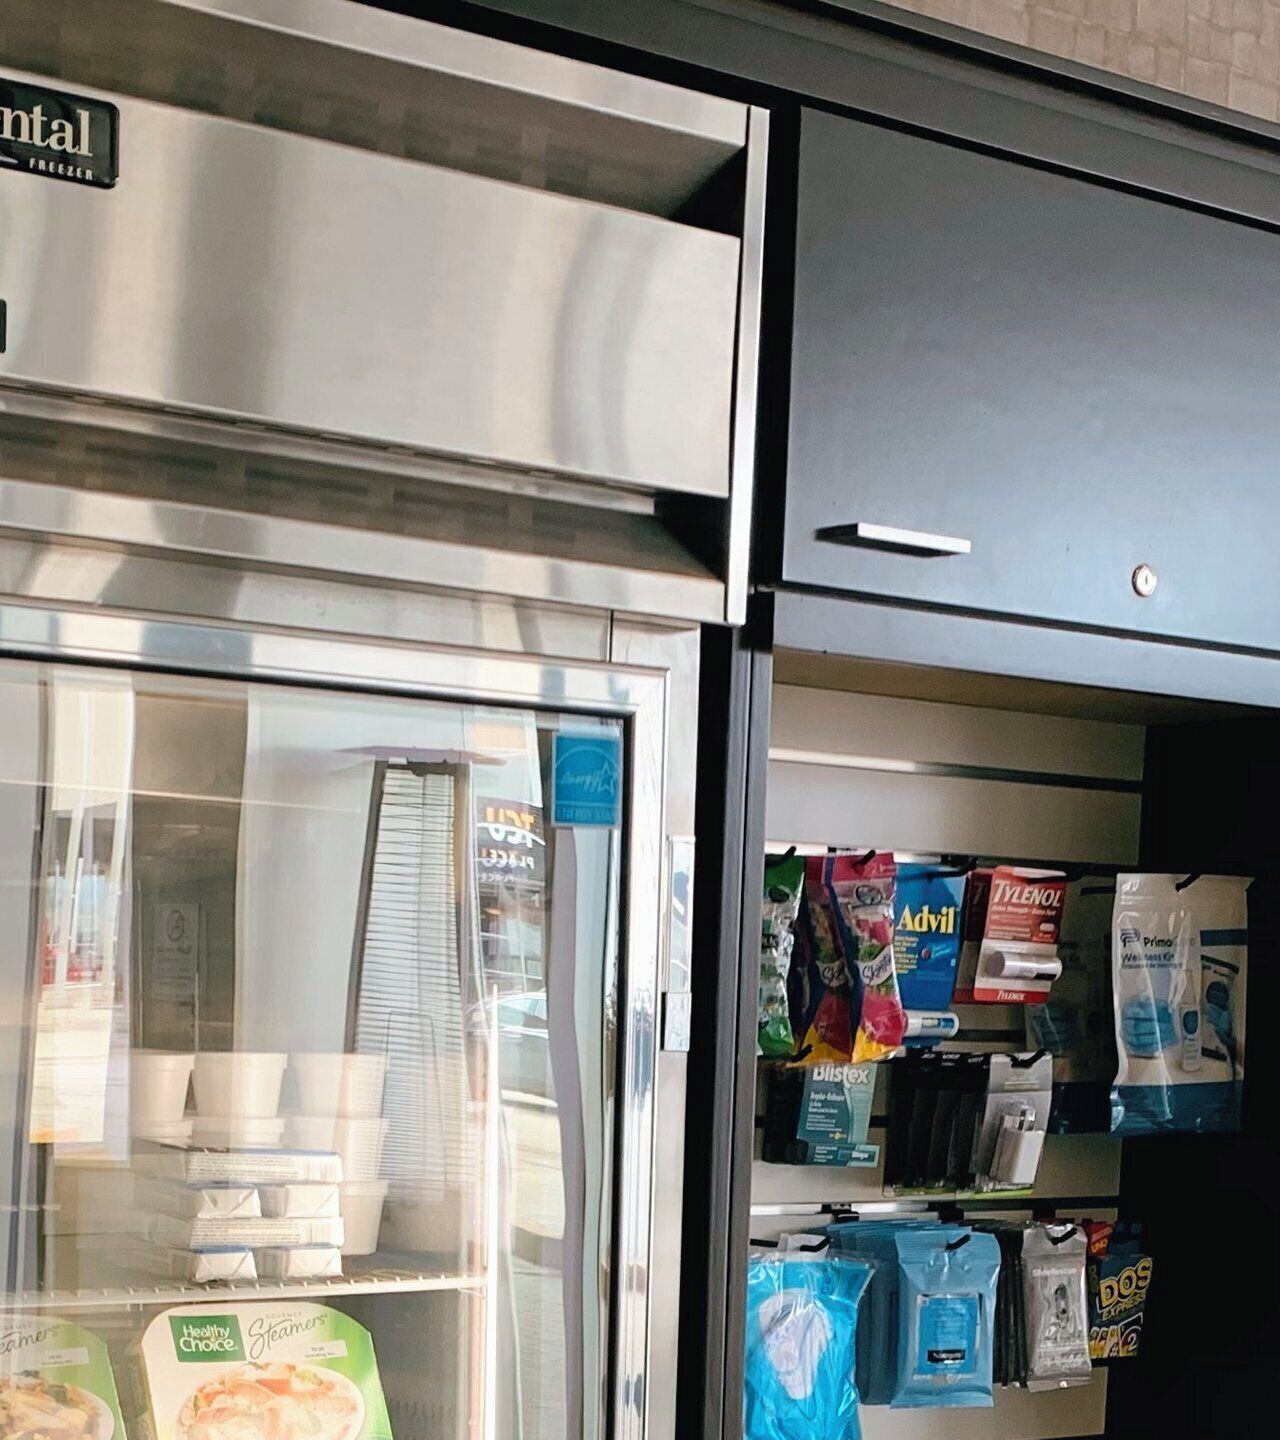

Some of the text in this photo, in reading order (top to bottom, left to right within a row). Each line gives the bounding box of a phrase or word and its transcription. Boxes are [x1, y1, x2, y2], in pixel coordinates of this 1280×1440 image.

[29, 157, 94, 181] FREEZER
[993, 880, 1061, 907] TYLENOL
[897, 905, 956, 934] Advil
[813, 1065, 869, 1088] Blistex
[1099, 1257, 1153, 1309] DOS
[180, 1336, 234, 1352] Choice
[183, 1325, 230, 1339] Healthy
[248, 1314, 325, 1360] Steamers
